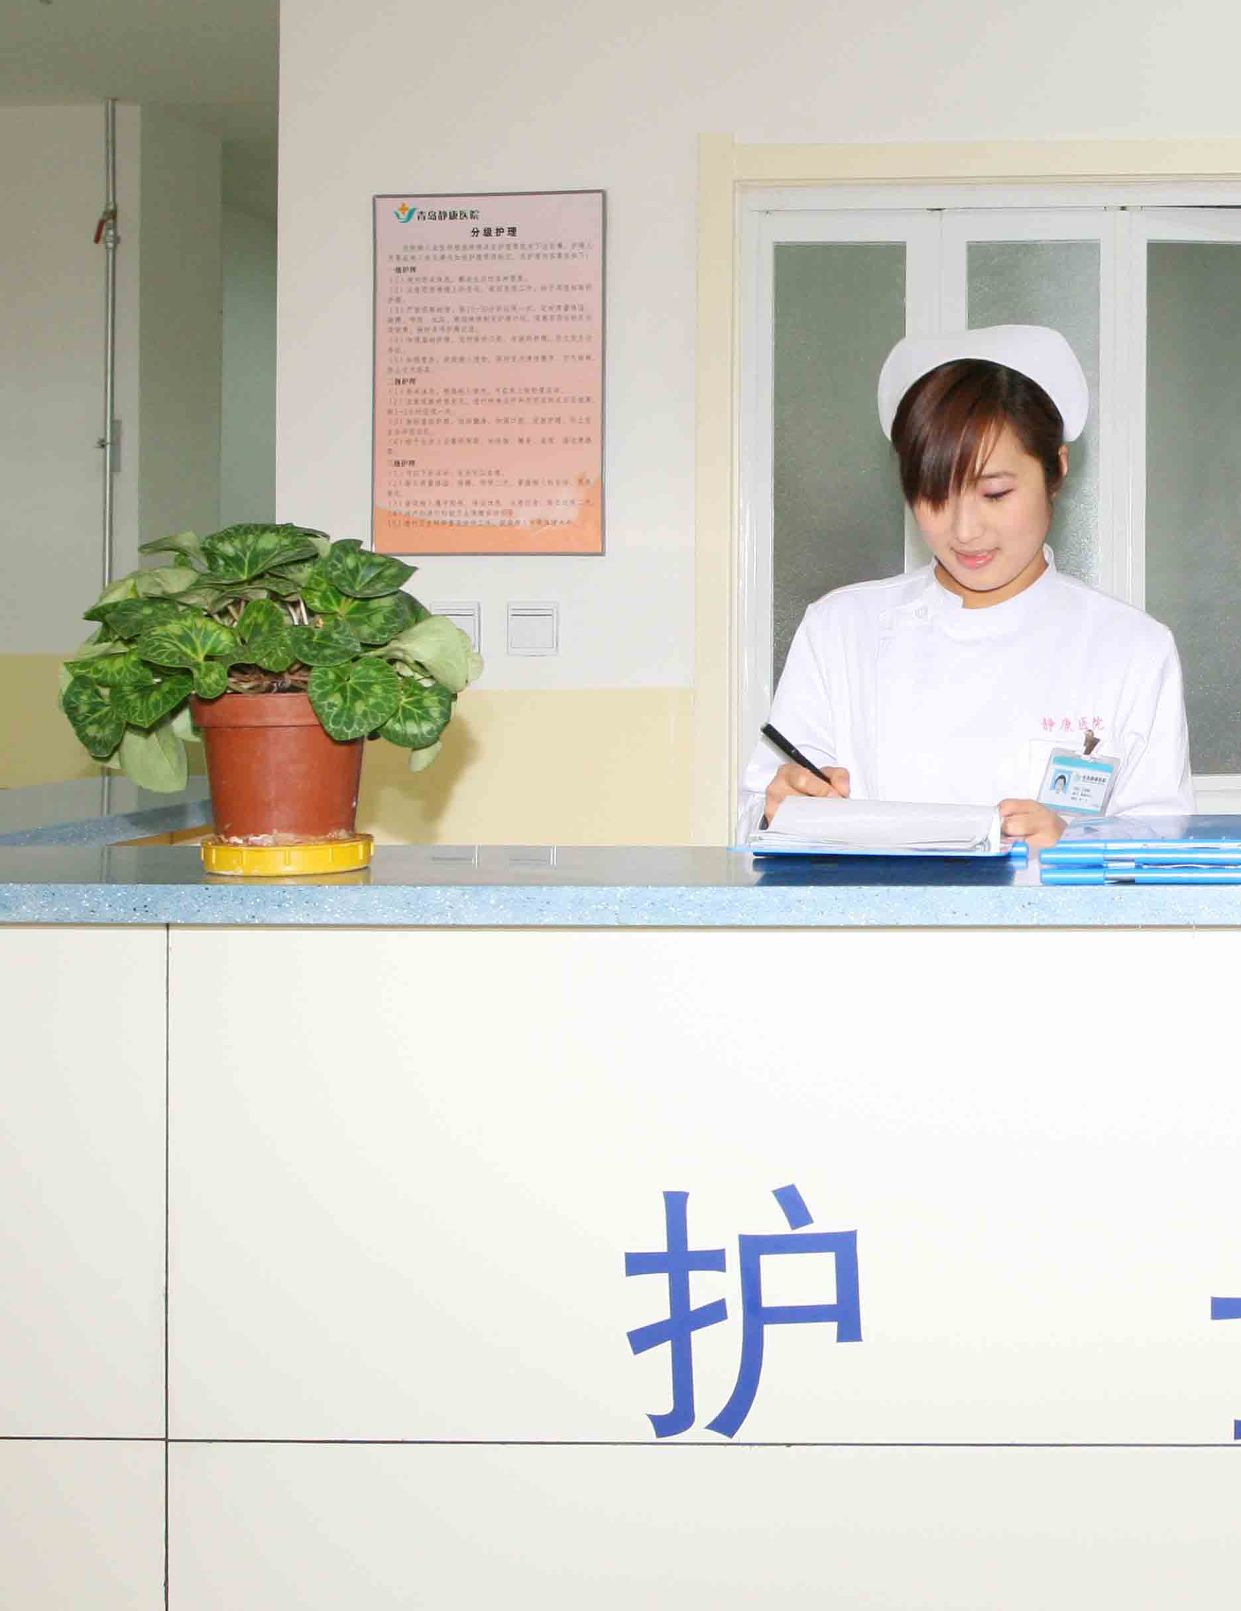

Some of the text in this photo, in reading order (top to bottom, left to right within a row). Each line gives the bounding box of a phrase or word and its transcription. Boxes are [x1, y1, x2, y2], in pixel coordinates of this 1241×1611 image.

[417, 209, 479, 221] 青岛静康医院
[471, 227, 518, 238] 分级护理
